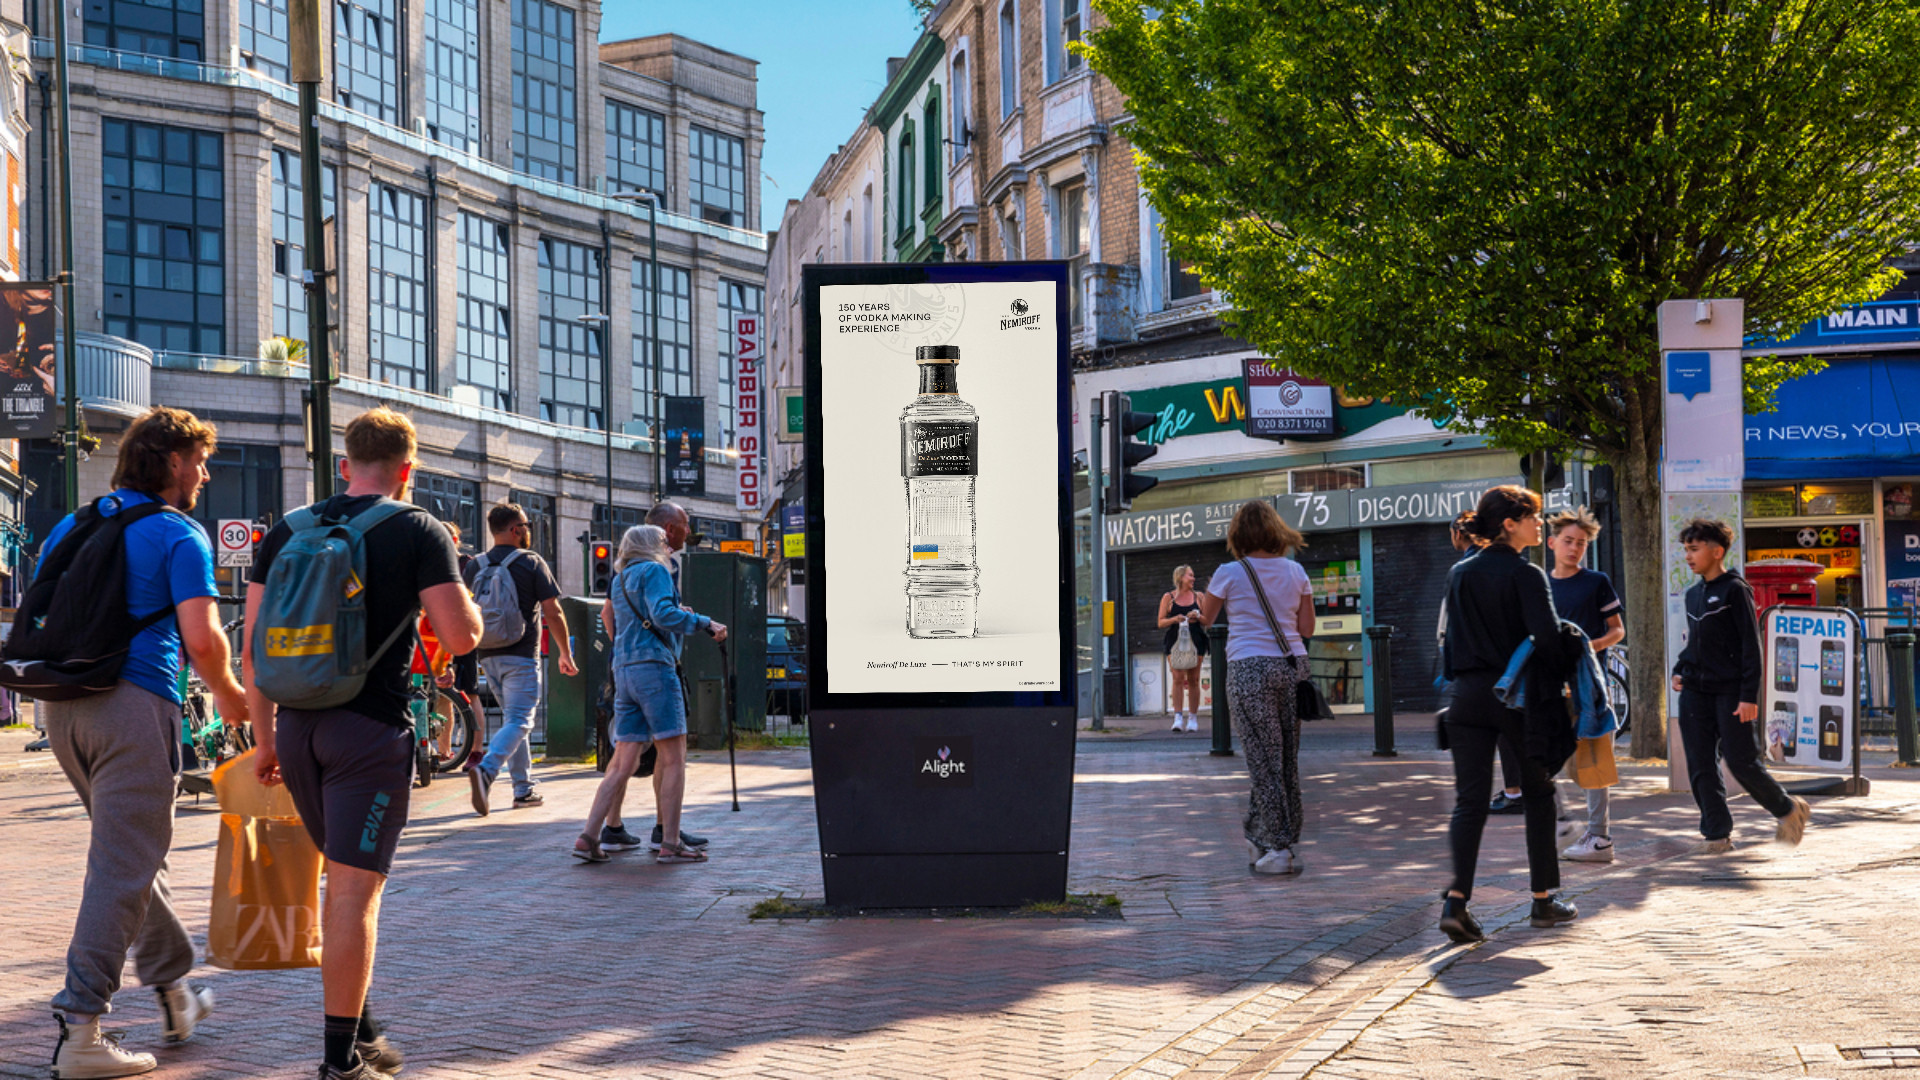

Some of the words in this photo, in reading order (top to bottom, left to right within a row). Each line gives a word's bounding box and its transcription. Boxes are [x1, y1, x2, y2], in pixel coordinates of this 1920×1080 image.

[838, 303, 856, 312] 150
[858, 302, 890, 312] YEARS
[838, 314, 852, 323] OF
[854, 313, 889, 322] VODKA
[891, 312, 931, 322] MAKING
[1000, 313, 1041, 331] NEMIROFF
[1828, 308, 1908, 329] MAIN
[839, 324, 900, 333] EXPERIENCE
[738, 318, 757, 428] BARBER
[1249, 364, 1283, 377] SHOP
[1257, 407, 1304, 416] GROSVENOR
[1305, 407, 1326, 416] DEAN
[1257, 419, 1276, 429] 020
[1277, 419, 1301, 429] 8371
[1303, 419, 1327, 429] 9161
[1768, 424, 1847, 441] NEWS,
[1851, 421, 1920, 439] YOUR
[907, 432, 970, 458] NEMIROFF
[739, 436, 758, 507] SHOP
[1294, 492, 1331, 528] 73
[1358, 490, 1465, 523] DISCOUNT
[225, 529, 246, 542] 30
[1775, 615, 1847, 638] REPAIR
[866, 661, 898, 669] Nemiroff
[996, 660, 1024, 668] SPIRIT
[921, 759, 966, 778] Alight
